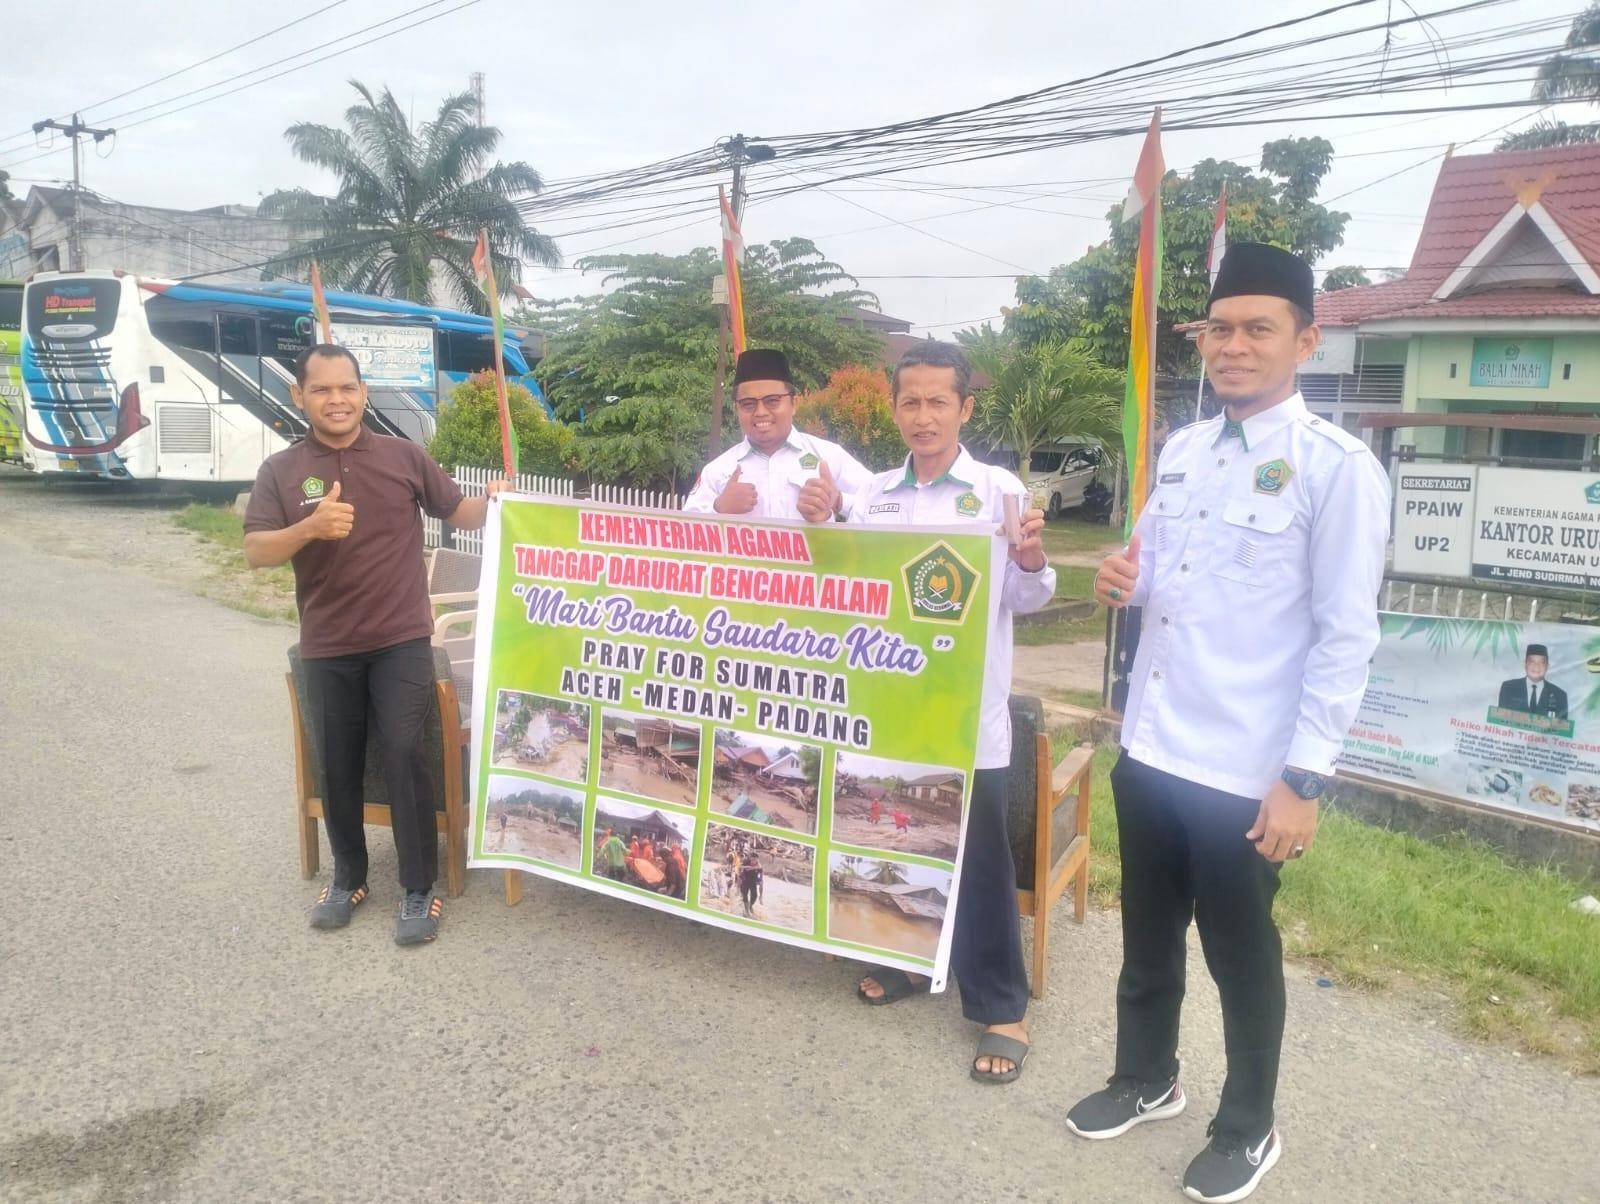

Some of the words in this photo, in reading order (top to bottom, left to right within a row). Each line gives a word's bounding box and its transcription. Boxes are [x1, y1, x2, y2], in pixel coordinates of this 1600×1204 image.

[45, 296, 60, 308] HD
[1480, 363, 1507, 378] BALAI
[1511, 363, 1542, 379] NIKAH
[1403, 478, 1470, 490] SEKRETARIAT
[1405, 500, 1463, 518] PPAIW
[1494, 506, 1558, 520] KEMENTERIAN
[1560, 511, 1594, 522] AGAMA
[581, 512, 723, 554] KEMENTERIAN
[727, 526, 810, 562] AGAMA
[1414, 535, 1450, 552] UP2
[1480, 520, 1554, 546] KANTOR
[1560, 527, 1600, 550] URU
[1507, 548, 1586, 566] KECAMATAN
[515, 546, 604, 582] TANGGAP
[608, 556, 707, 594] DARURAT
[711, 566, 816, 607] BENCANA
[820, 577, 890, 616] ALAM
[1507, 568, 1533, 579] JEND
[1534, 570, 1586, 585] SUDIRMAN
[605, 597, 696, 640] Bantu
[704, 609, 840, 660] Saudara
[845, 626, 926, 672] Kita
[583, 640, 646, 671] PRAY
[656, 651, 704, 680] FOR
[716, 659, 846, 704] SUMATRA
[562, 670, 621, 701] ACEH
[758, 701, 869, 746] PADANG
[1450, 718, 1481, 731] Risiko
[1485, 725, 1514, 737] Nikah
[1519, 731, 1548, 744] Tidak
